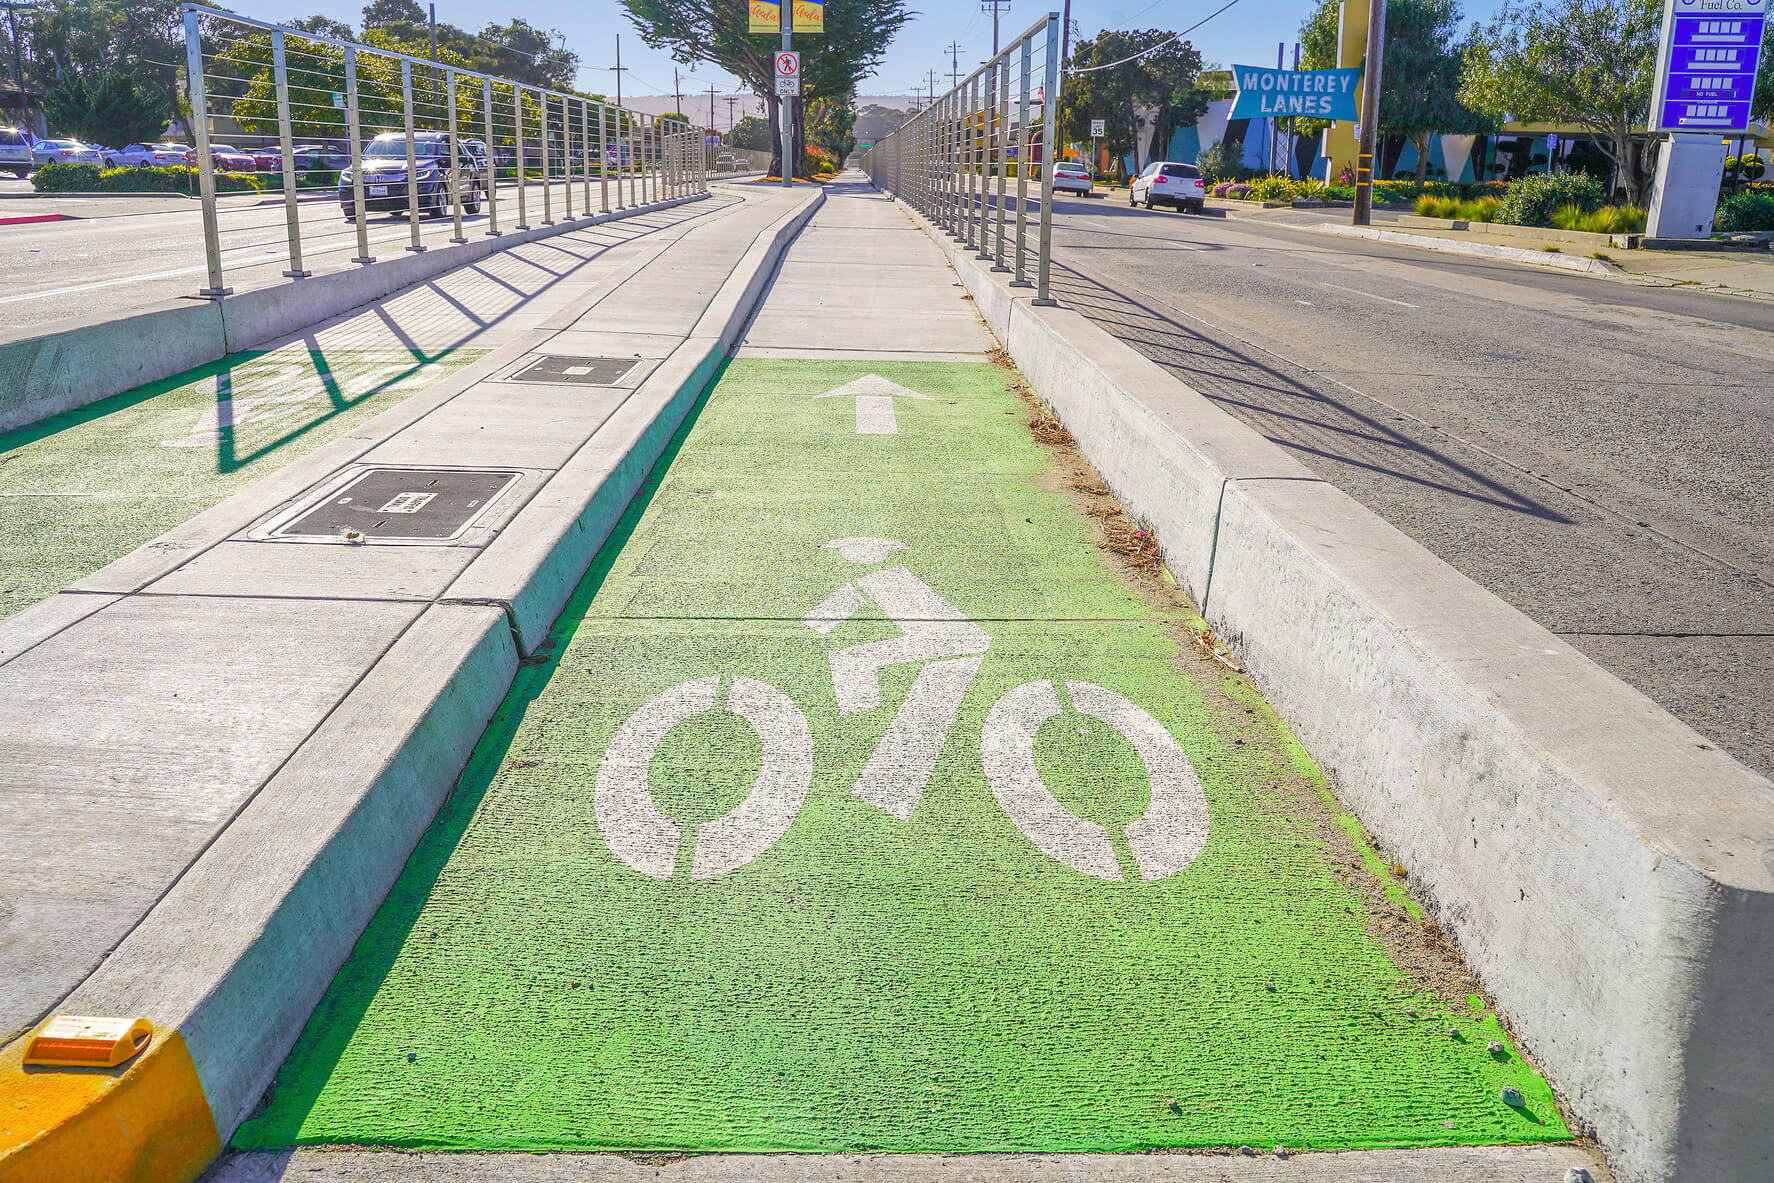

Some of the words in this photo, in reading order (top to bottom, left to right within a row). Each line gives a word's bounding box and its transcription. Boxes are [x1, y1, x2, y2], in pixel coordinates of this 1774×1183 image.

[1700, 0, 1723, 9] Fuel
[1242, 72, 1351, 93] MONTEREY
[1261, 94, 1333, 114] LANES
